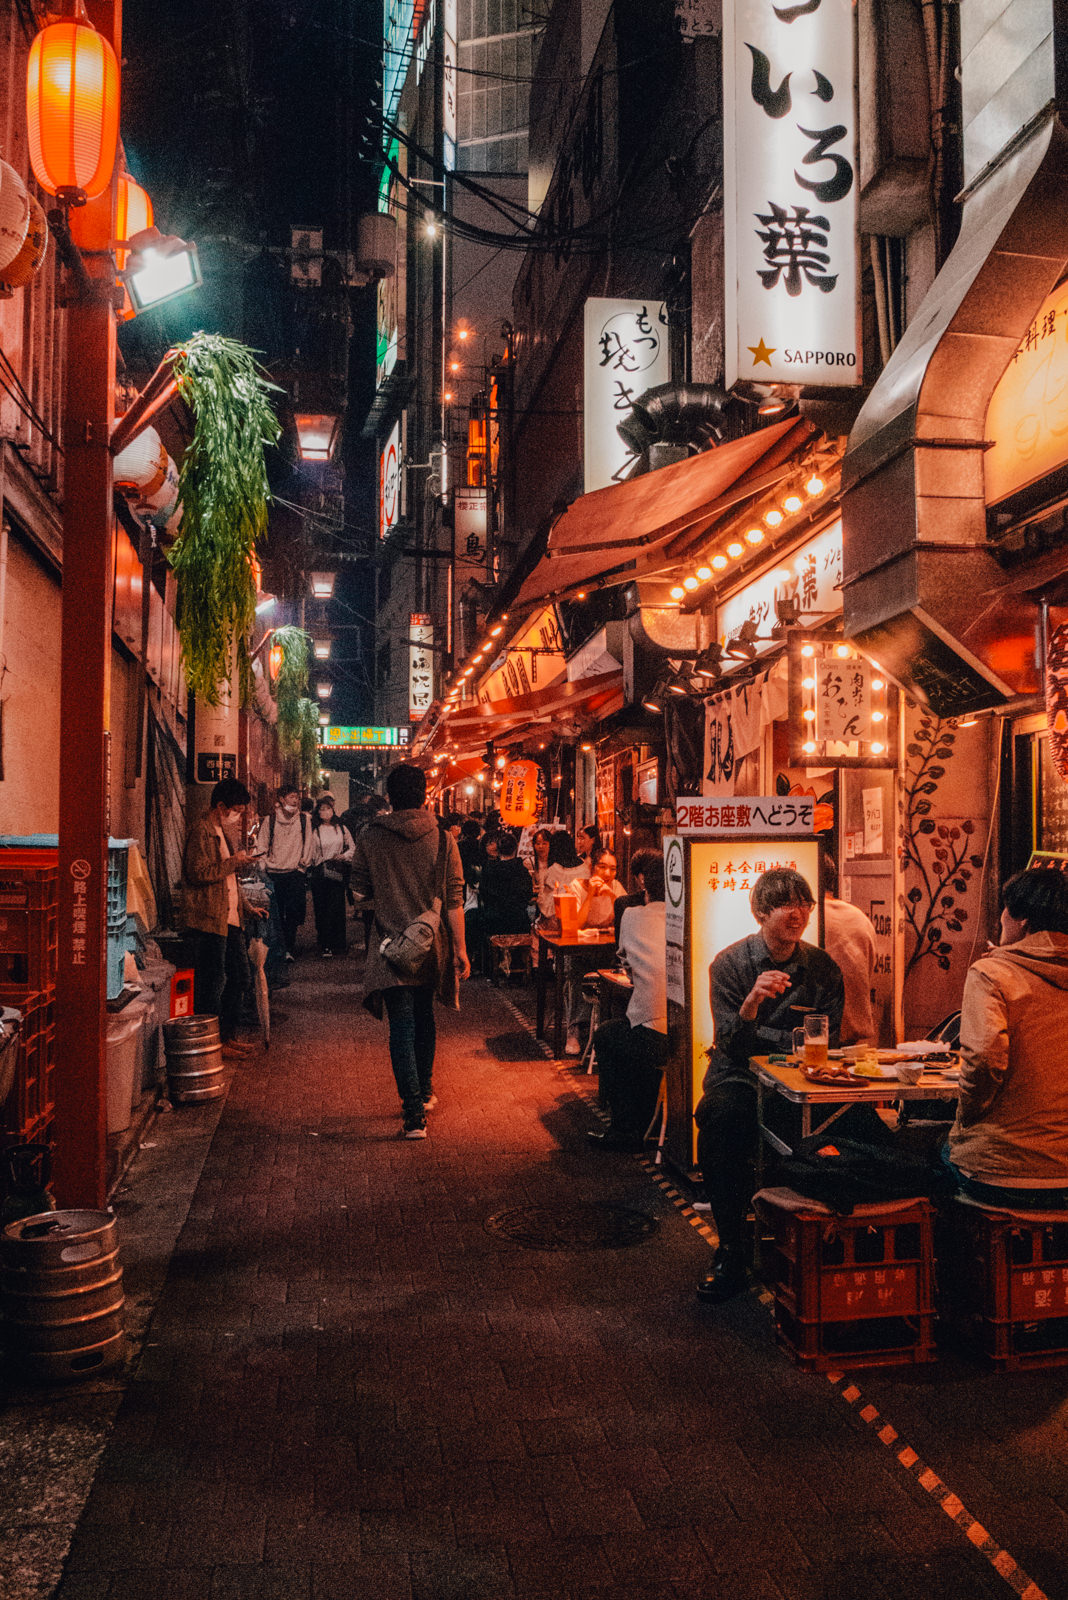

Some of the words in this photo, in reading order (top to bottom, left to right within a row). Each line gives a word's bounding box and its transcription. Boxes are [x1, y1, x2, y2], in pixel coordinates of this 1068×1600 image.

[784, 348, 857, 367] SAPPORO
[677, 804, 813, 828] 2階お座敷へどうぞ
